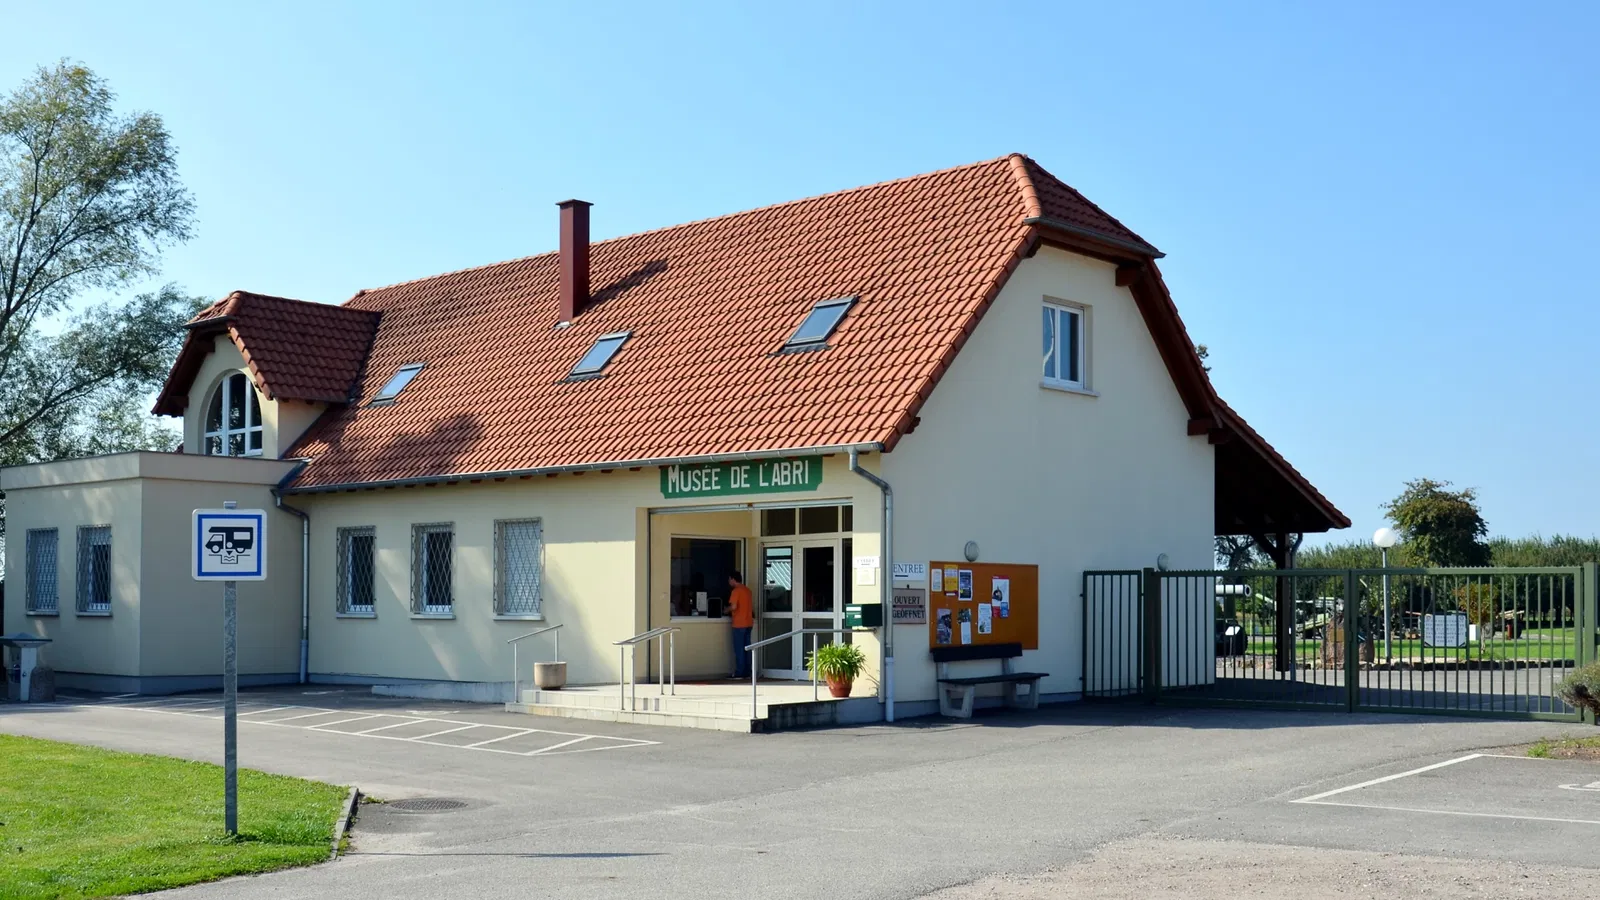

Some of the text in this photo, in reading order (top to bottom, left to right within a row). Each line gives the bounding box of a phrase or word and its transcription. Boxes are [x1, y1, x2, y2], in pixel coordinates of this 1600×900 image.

[730, 465, 750, 488] DE
[759, 460, 809, 487] L'ABRI
[894, 596, 920, 605] OUVERT
